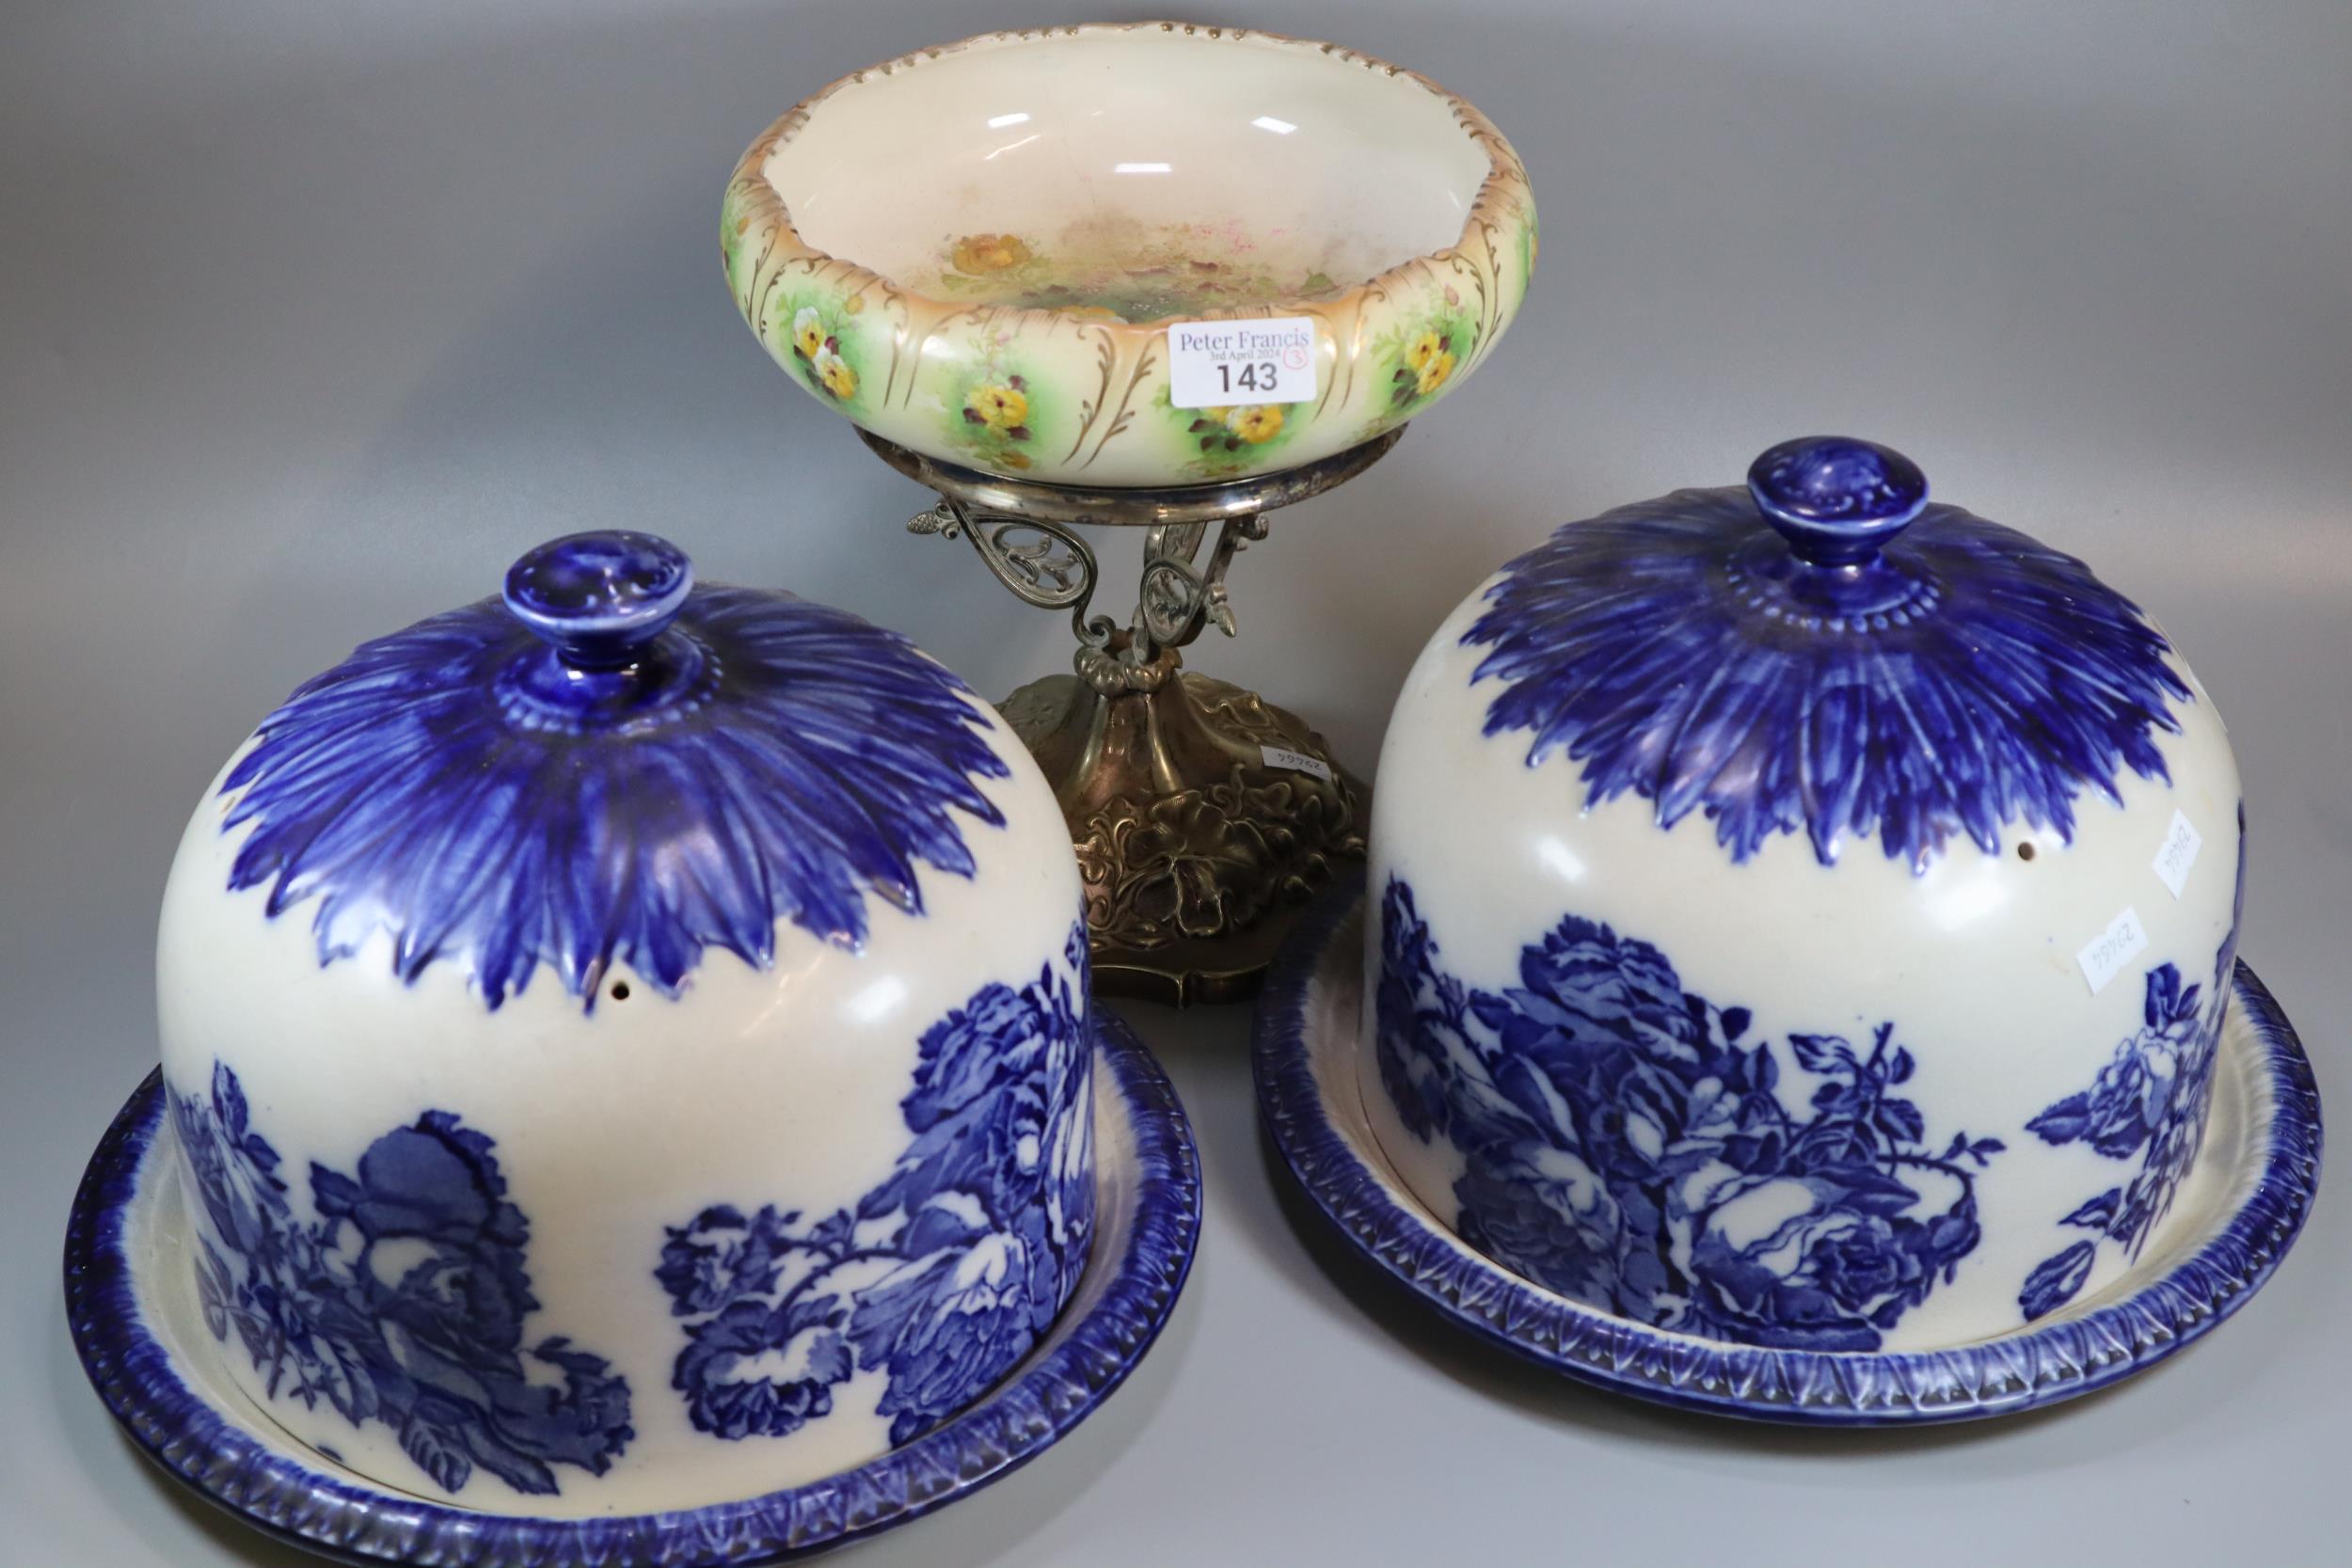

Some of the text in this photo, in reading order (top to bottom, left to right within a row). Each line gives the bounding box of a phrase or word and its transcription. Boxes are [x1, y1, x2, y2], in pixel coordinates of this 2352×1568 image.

[1181, 327, 1310, 352] Peter Francis
[1210, 348, 1281, 362] 3rd April 2024
[1217, 362, 1279, 392] 143
